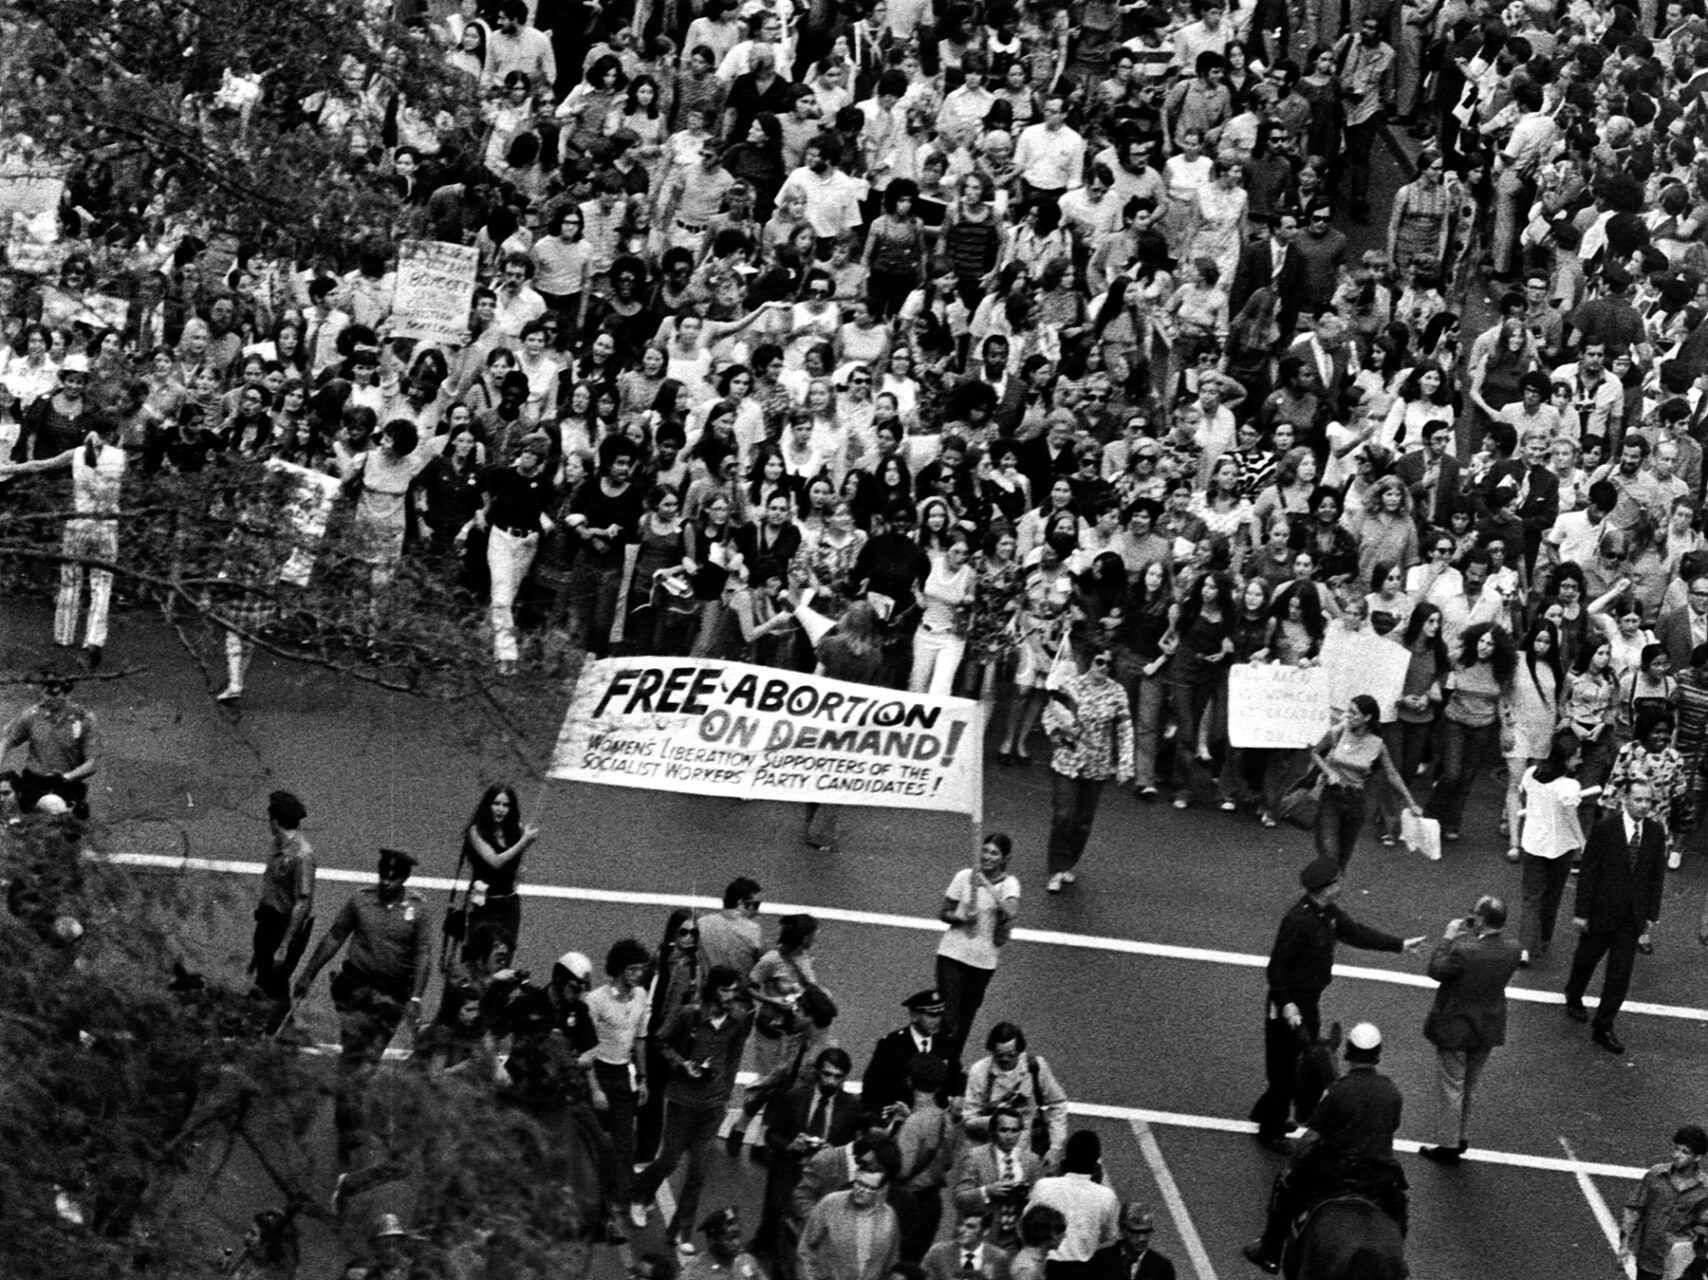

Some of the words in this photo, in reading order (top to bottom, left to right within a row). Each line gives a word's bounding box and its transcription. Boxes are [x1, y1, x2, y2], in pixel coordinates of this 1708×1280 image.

[410, 271, 470, 293] BOYCOTT
[592, 667, 724, 718] FREE
[725, 674, 941, 729] ABORTION
[588, 733, 657, 757] WOMEN'S
[660, 737, 757, 767] LIBERATION
[760, 751, 868, 775] SUPPORTERS
[869, 762, 893, 776] OF
[901, 764, 932, 782] THE
[699, 709, 760, 748] ON
[764, 720, 968, 768] DEMAND!
[580, 752, 662, 777] SOCIALIST
[664, 761, 747, 785] WORKERS
[752, 769, 812, 788] PARTY
[816, 773, 943, 798] CANDIDATES!
